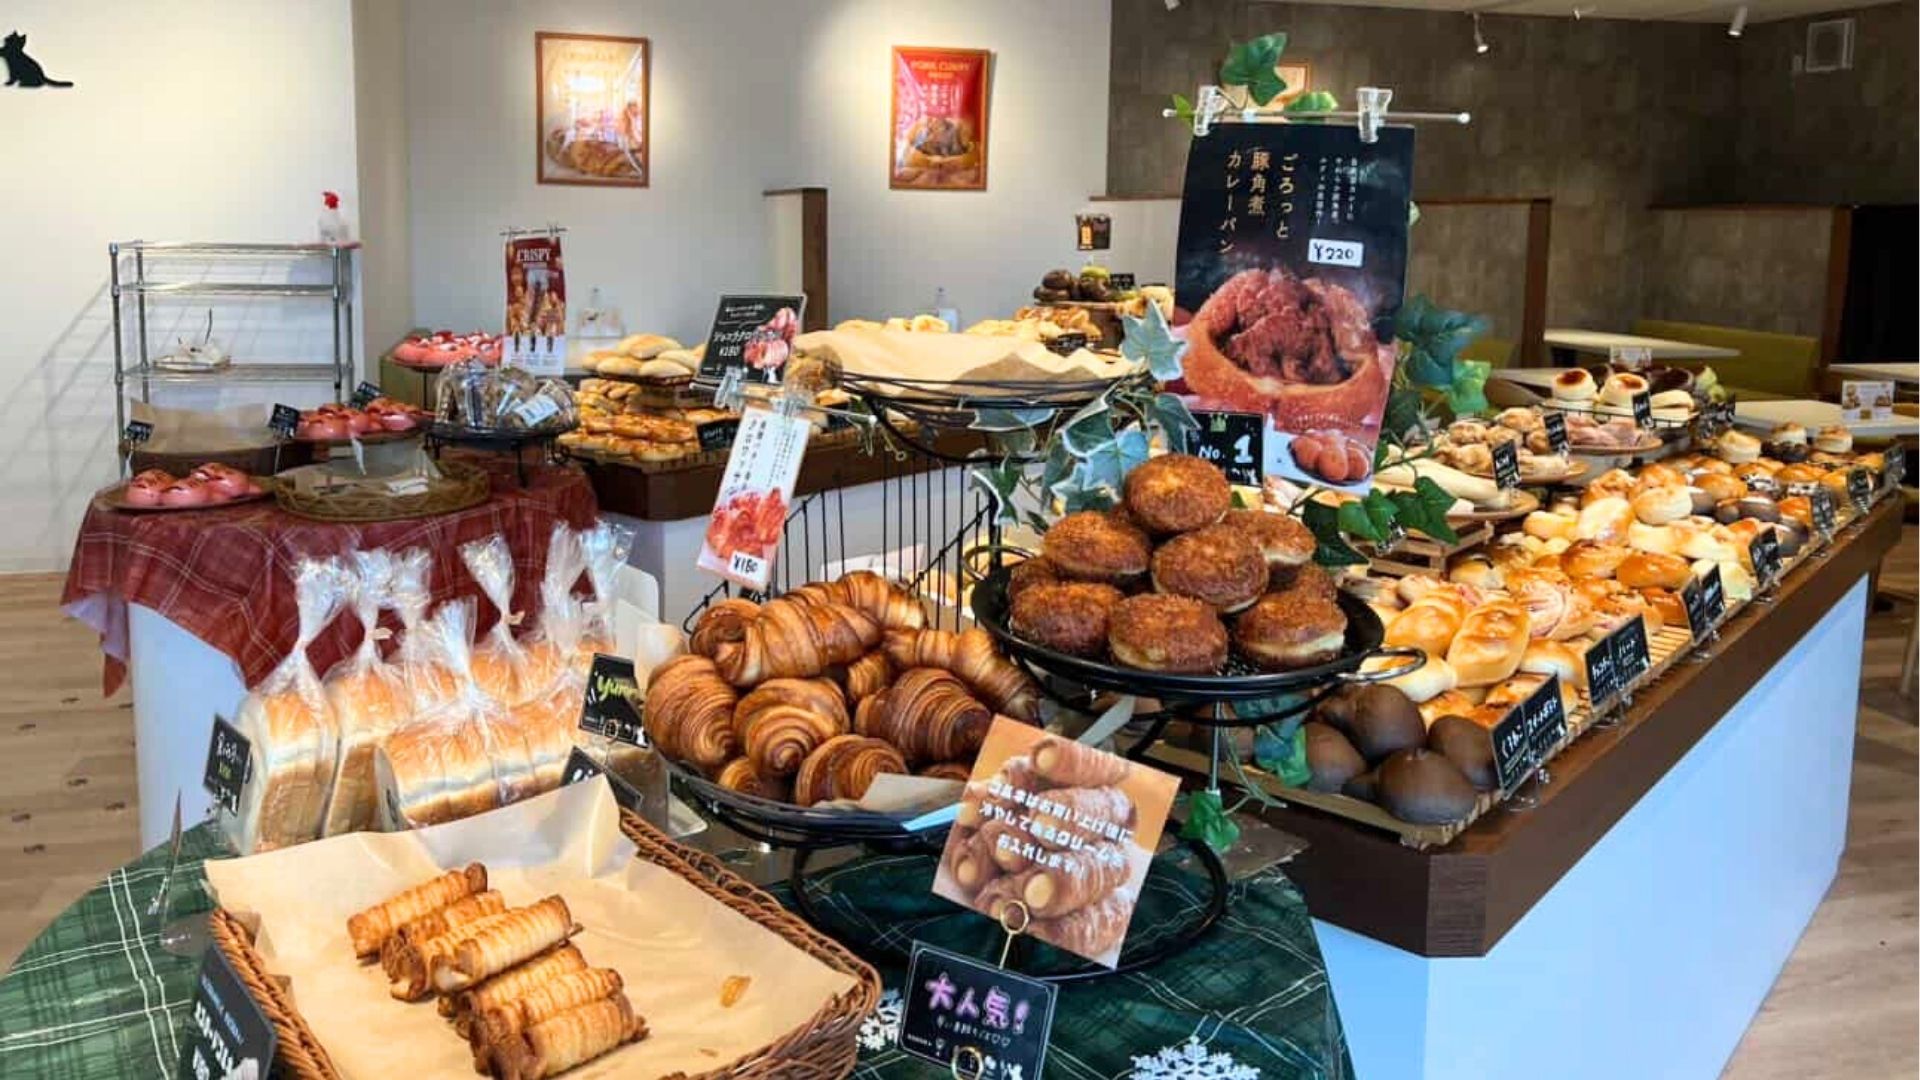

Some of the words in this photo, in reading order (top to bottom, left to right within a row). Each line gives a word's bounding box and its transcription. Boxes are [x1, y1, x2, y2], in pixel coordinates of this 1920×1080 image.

[1219, 150, 1243, 254] カレーパン
[1247, 150, 1272, 217] 豚角煮
[1276, 153, 1299, 239] ごろっと
[516, 248, 552, 262] CRISPY
[1233, 433, 1254, 464] 1
